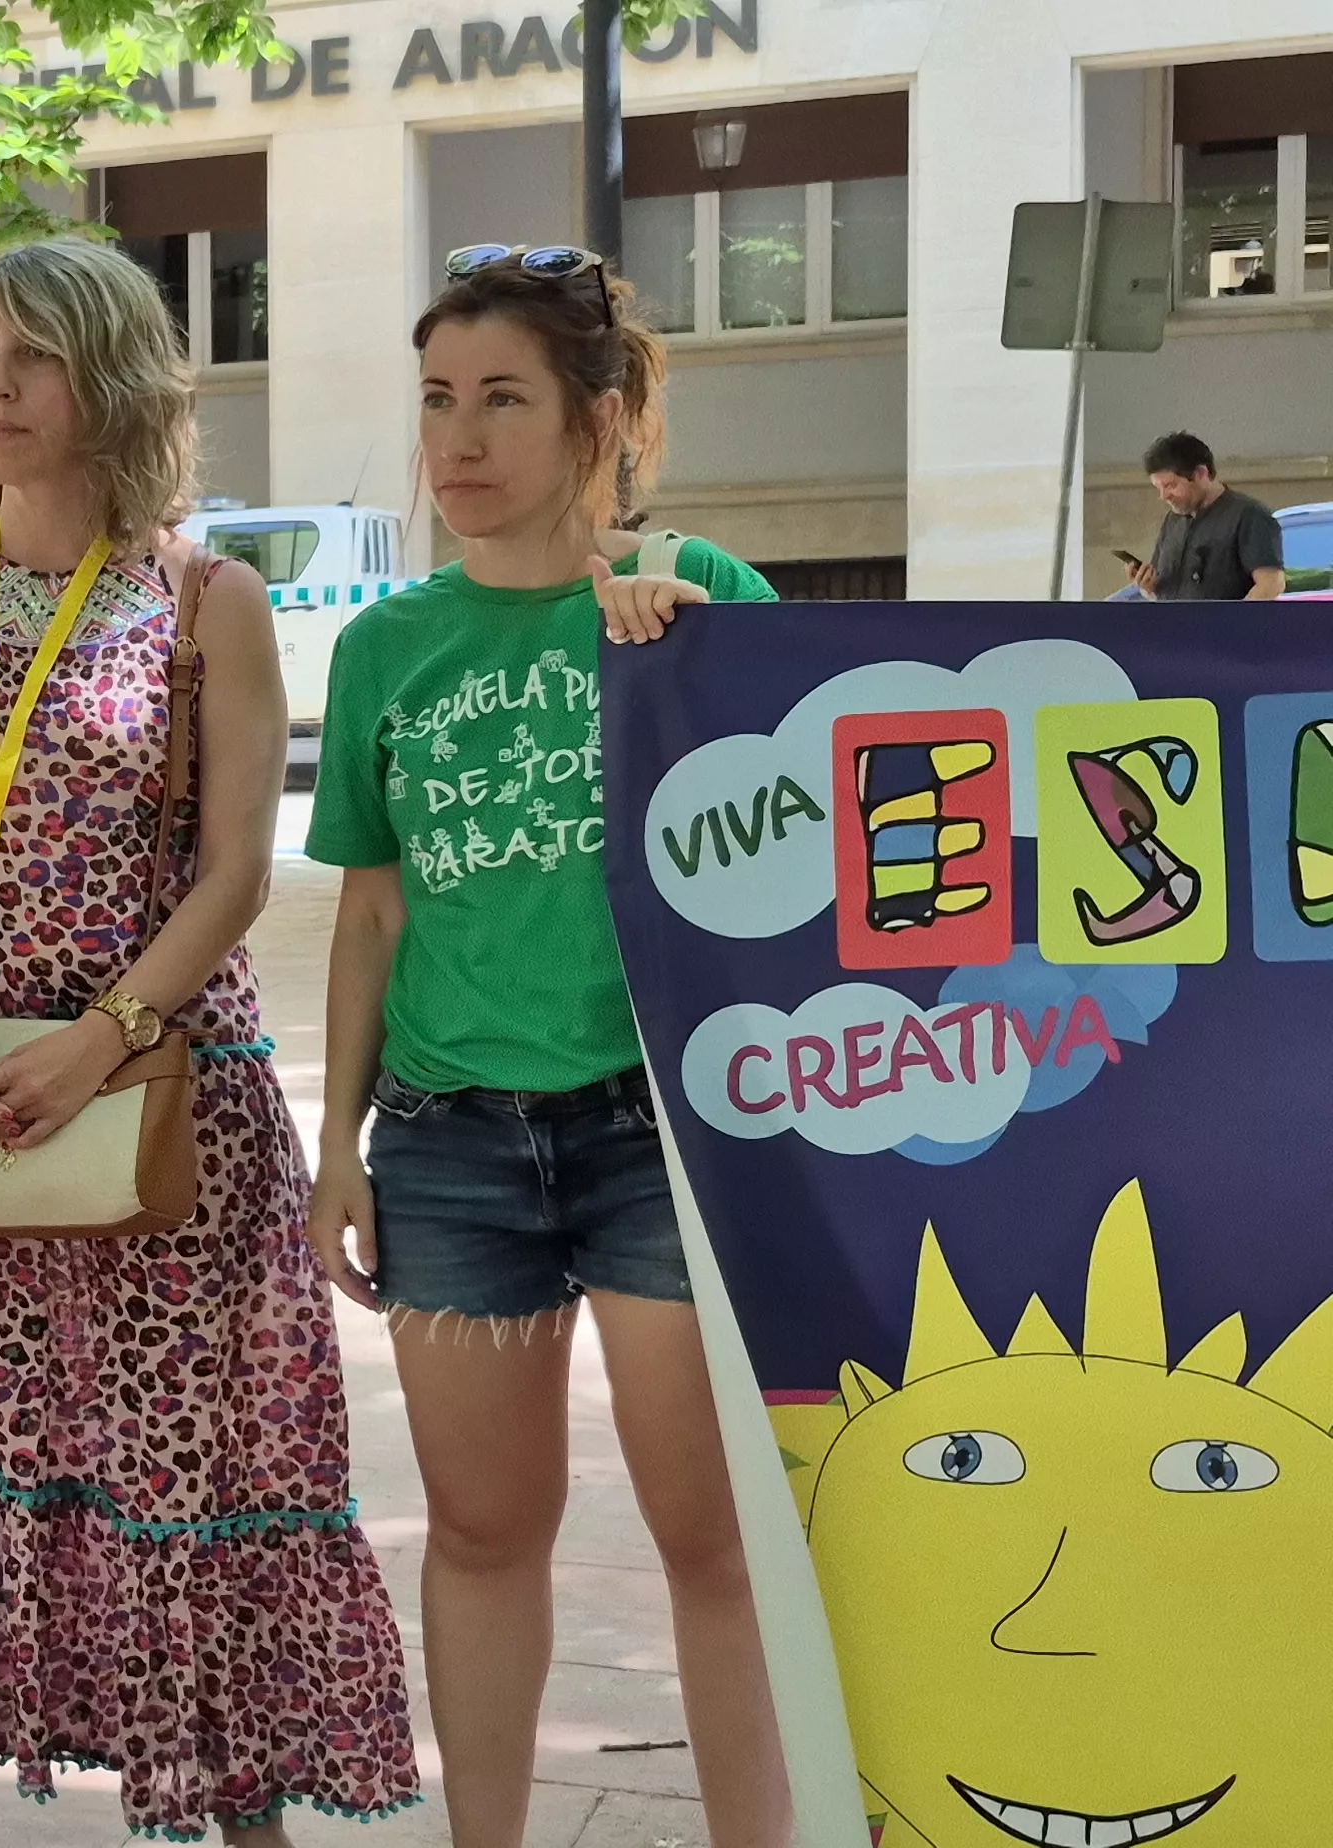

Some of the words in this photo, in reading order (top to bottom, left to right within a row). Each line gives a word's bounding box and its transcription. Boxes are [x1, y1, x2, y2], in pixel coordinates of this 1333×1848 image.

[250, 36, 351, 103] DE
[389, 663, 548, 740] ESCUELA
[422, 767, 489, 814] DE
[514, 747, 603, 791] TOD
[417, 828, 540, 885] PARA
[662, 774, 826, 878] VIVA
[726, 995, 1121, 1114] CREATIVA
